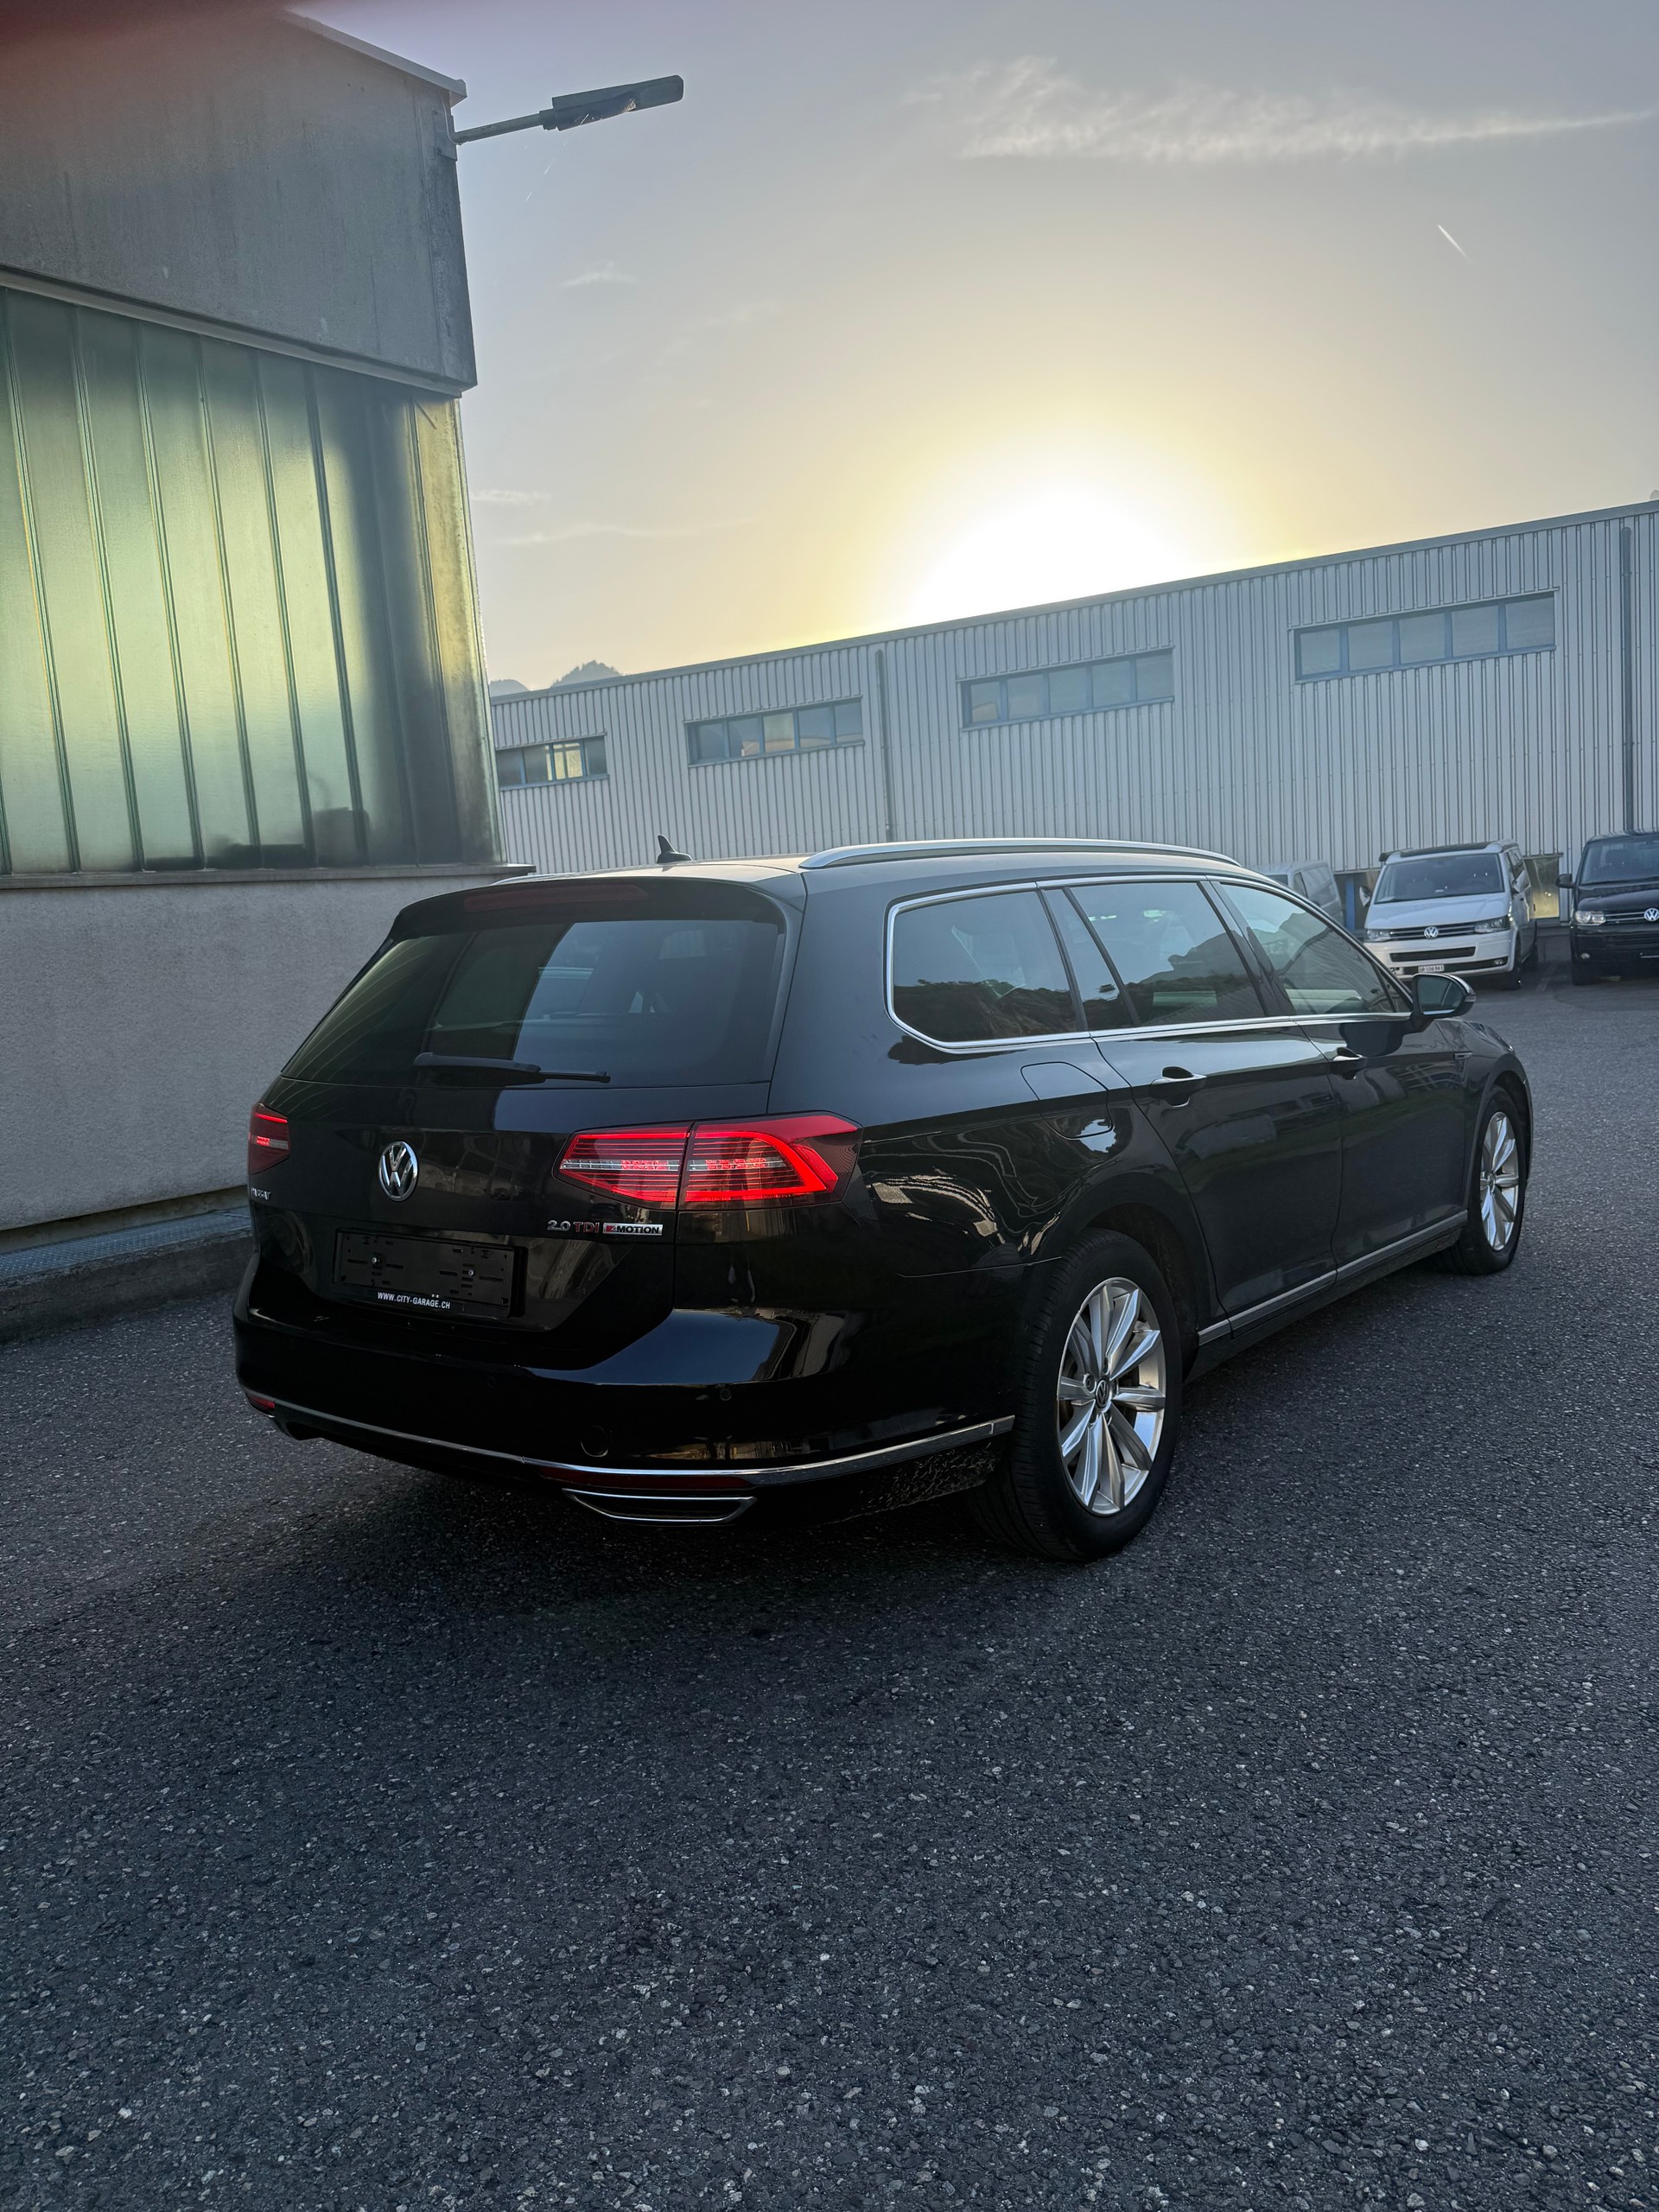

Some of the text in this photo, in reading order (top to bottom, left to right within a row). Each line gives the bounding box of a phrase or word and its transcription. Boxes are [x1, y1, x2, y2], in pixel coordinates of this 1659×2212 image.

[1424, 925, 1439, 939] VW
[378, 1141, 418, 1201] VW
[547, 1220, 571, 1231] 2.0
[573, 1221, 601, 1233] TDI
[377, 1291, 451, 1310] WWW.CITY-GARAGE.CH
